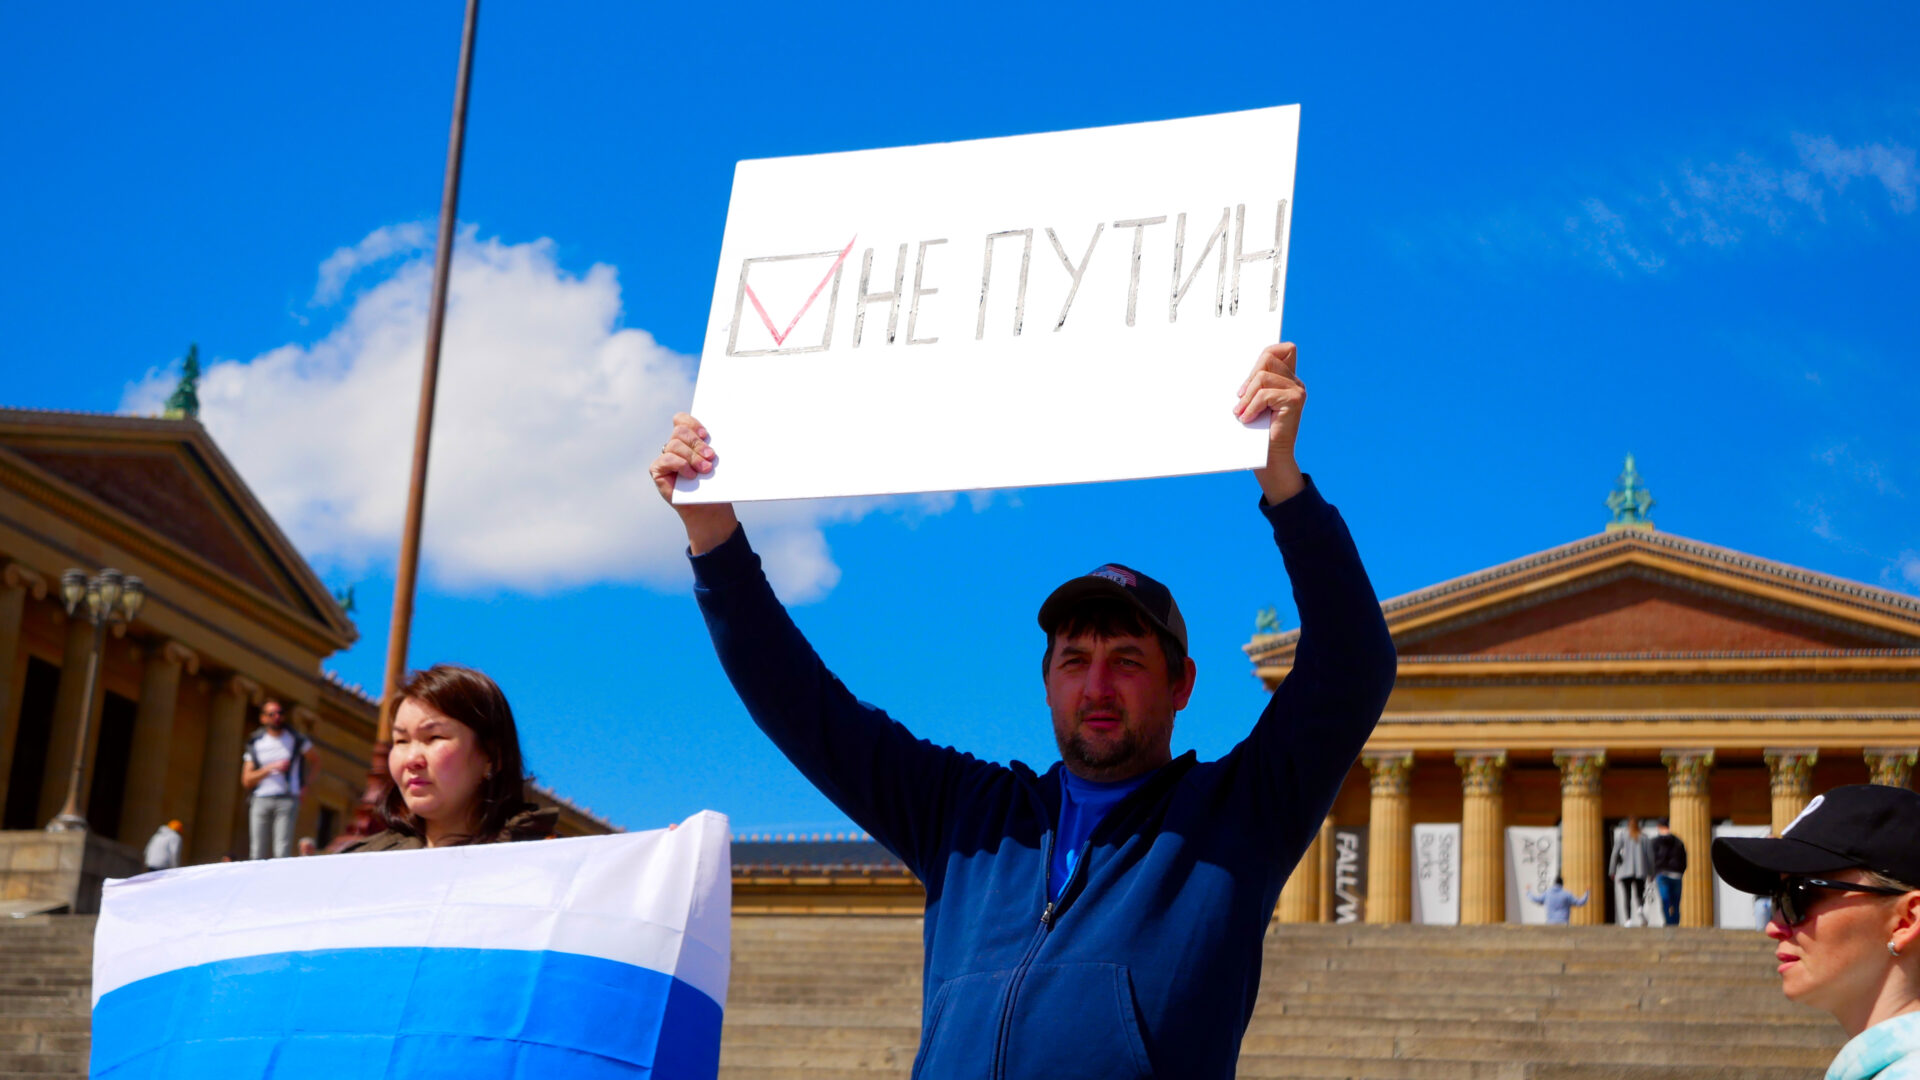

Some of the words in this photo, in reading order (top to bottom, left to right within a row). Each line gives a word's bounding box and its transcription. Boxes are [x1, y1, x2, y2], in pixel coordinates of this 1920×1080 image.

[853, 238, 949, 348] НЕ
[975, 198, 1288, 341] ПУТИН
[1434, 832, 1454, 904] Stephen
[1522, 838, 1535, 865] Art
